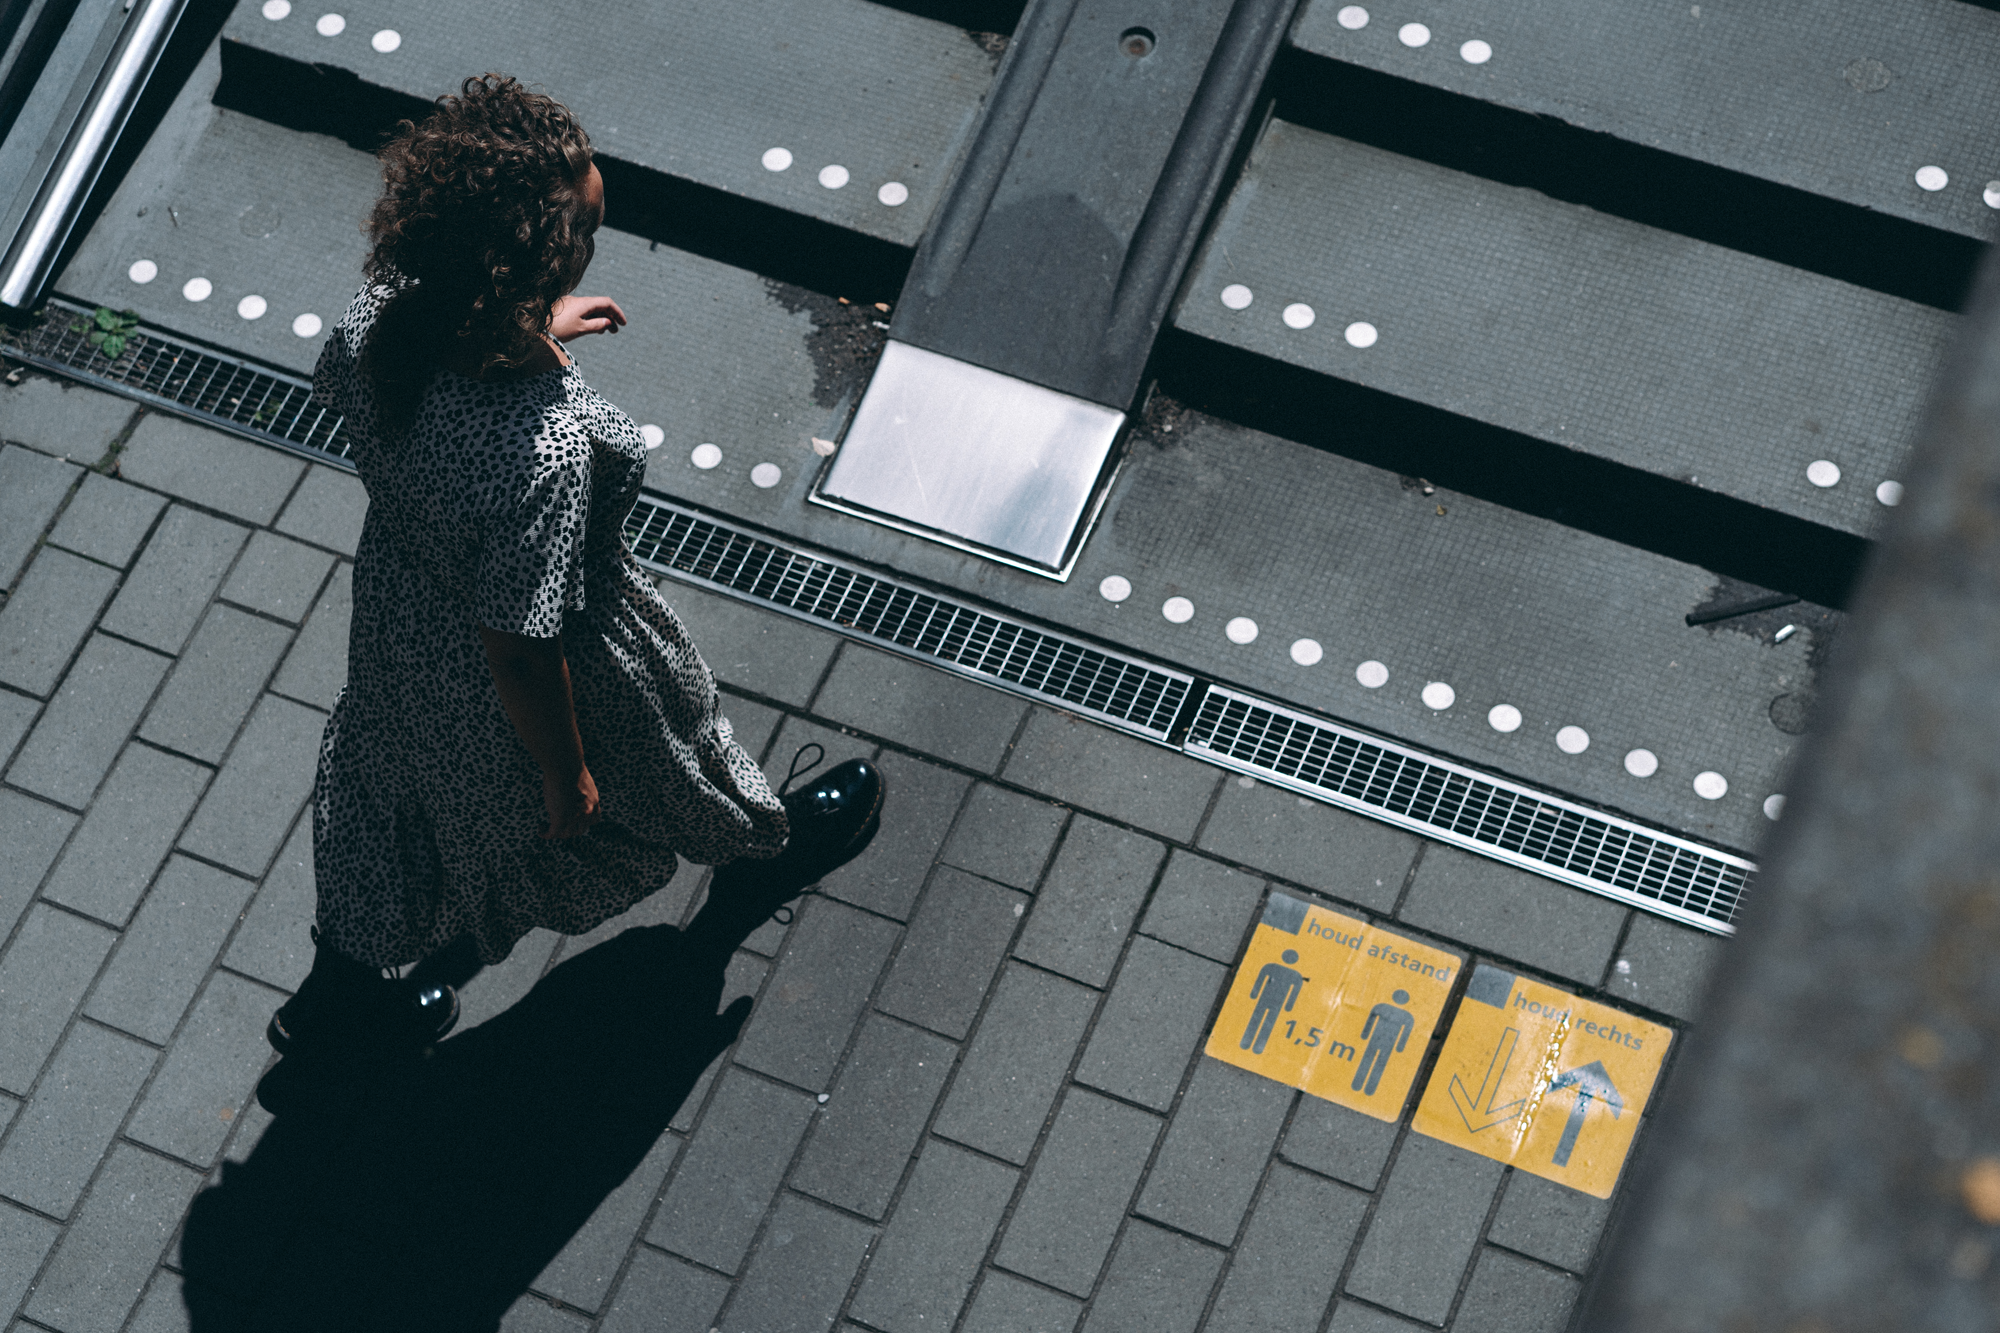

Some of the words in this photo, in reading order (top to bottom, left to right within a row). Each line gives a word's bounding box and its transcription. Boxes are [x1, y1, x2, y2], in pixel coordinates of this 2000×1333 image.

[1306, 918, 1365, 951] houd
[1366, 944, 1451, 983] afstand
[1285, 1019, 1325, 1048] 1,5
[1328, 1040, 1356, 1062] m
[1513, 991, 1573, 1029] houd
[1575, 1017, 1644, 1051] rechts
